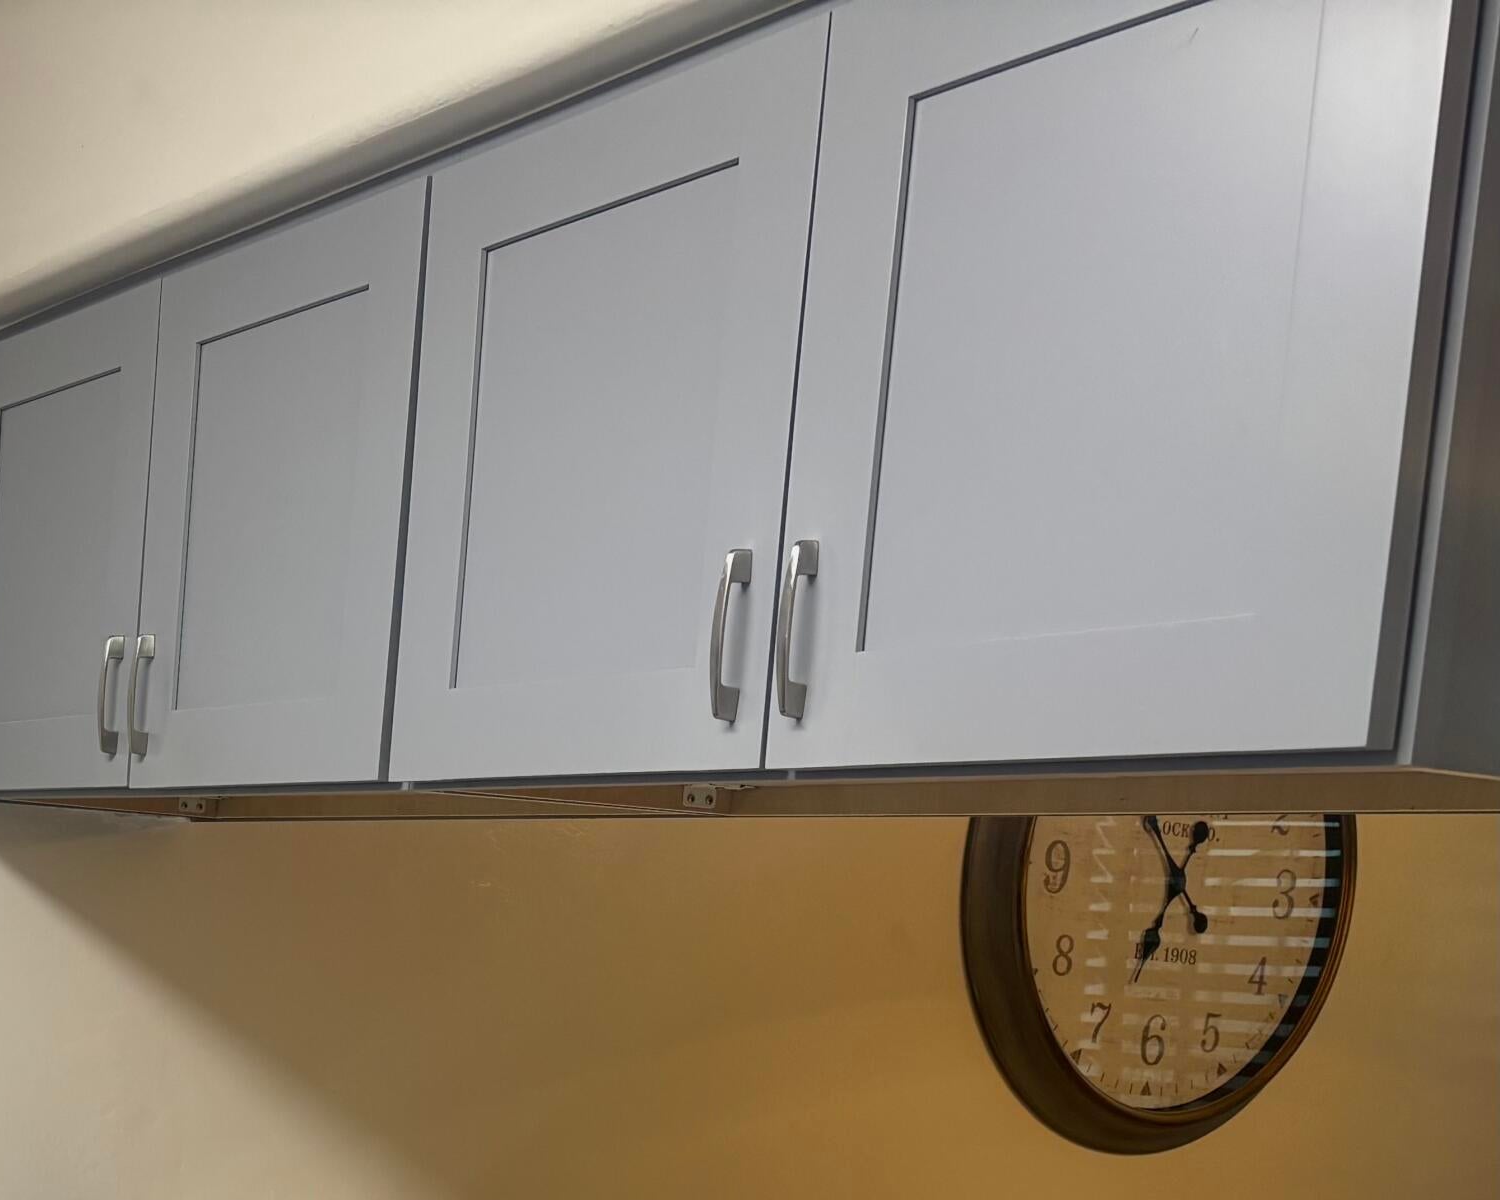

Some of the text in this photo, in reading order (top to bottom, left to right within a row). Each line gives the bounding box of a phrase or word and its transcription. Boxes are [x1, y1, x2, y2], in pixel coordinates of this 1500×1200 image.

[1043, 840, 1071, 894] 9
[1271, 869, 1297, 919] 3
[1051, 934, 1075, 977] 8
[1163, 946, 1197, 965] 1908
[1248, 956, 1268, 996] 4
[1089, 1001, 1112, 1044] 7
[1139, 1014, 1167, 1066] 6
[1201, 1012, 1222, 1053] 5
